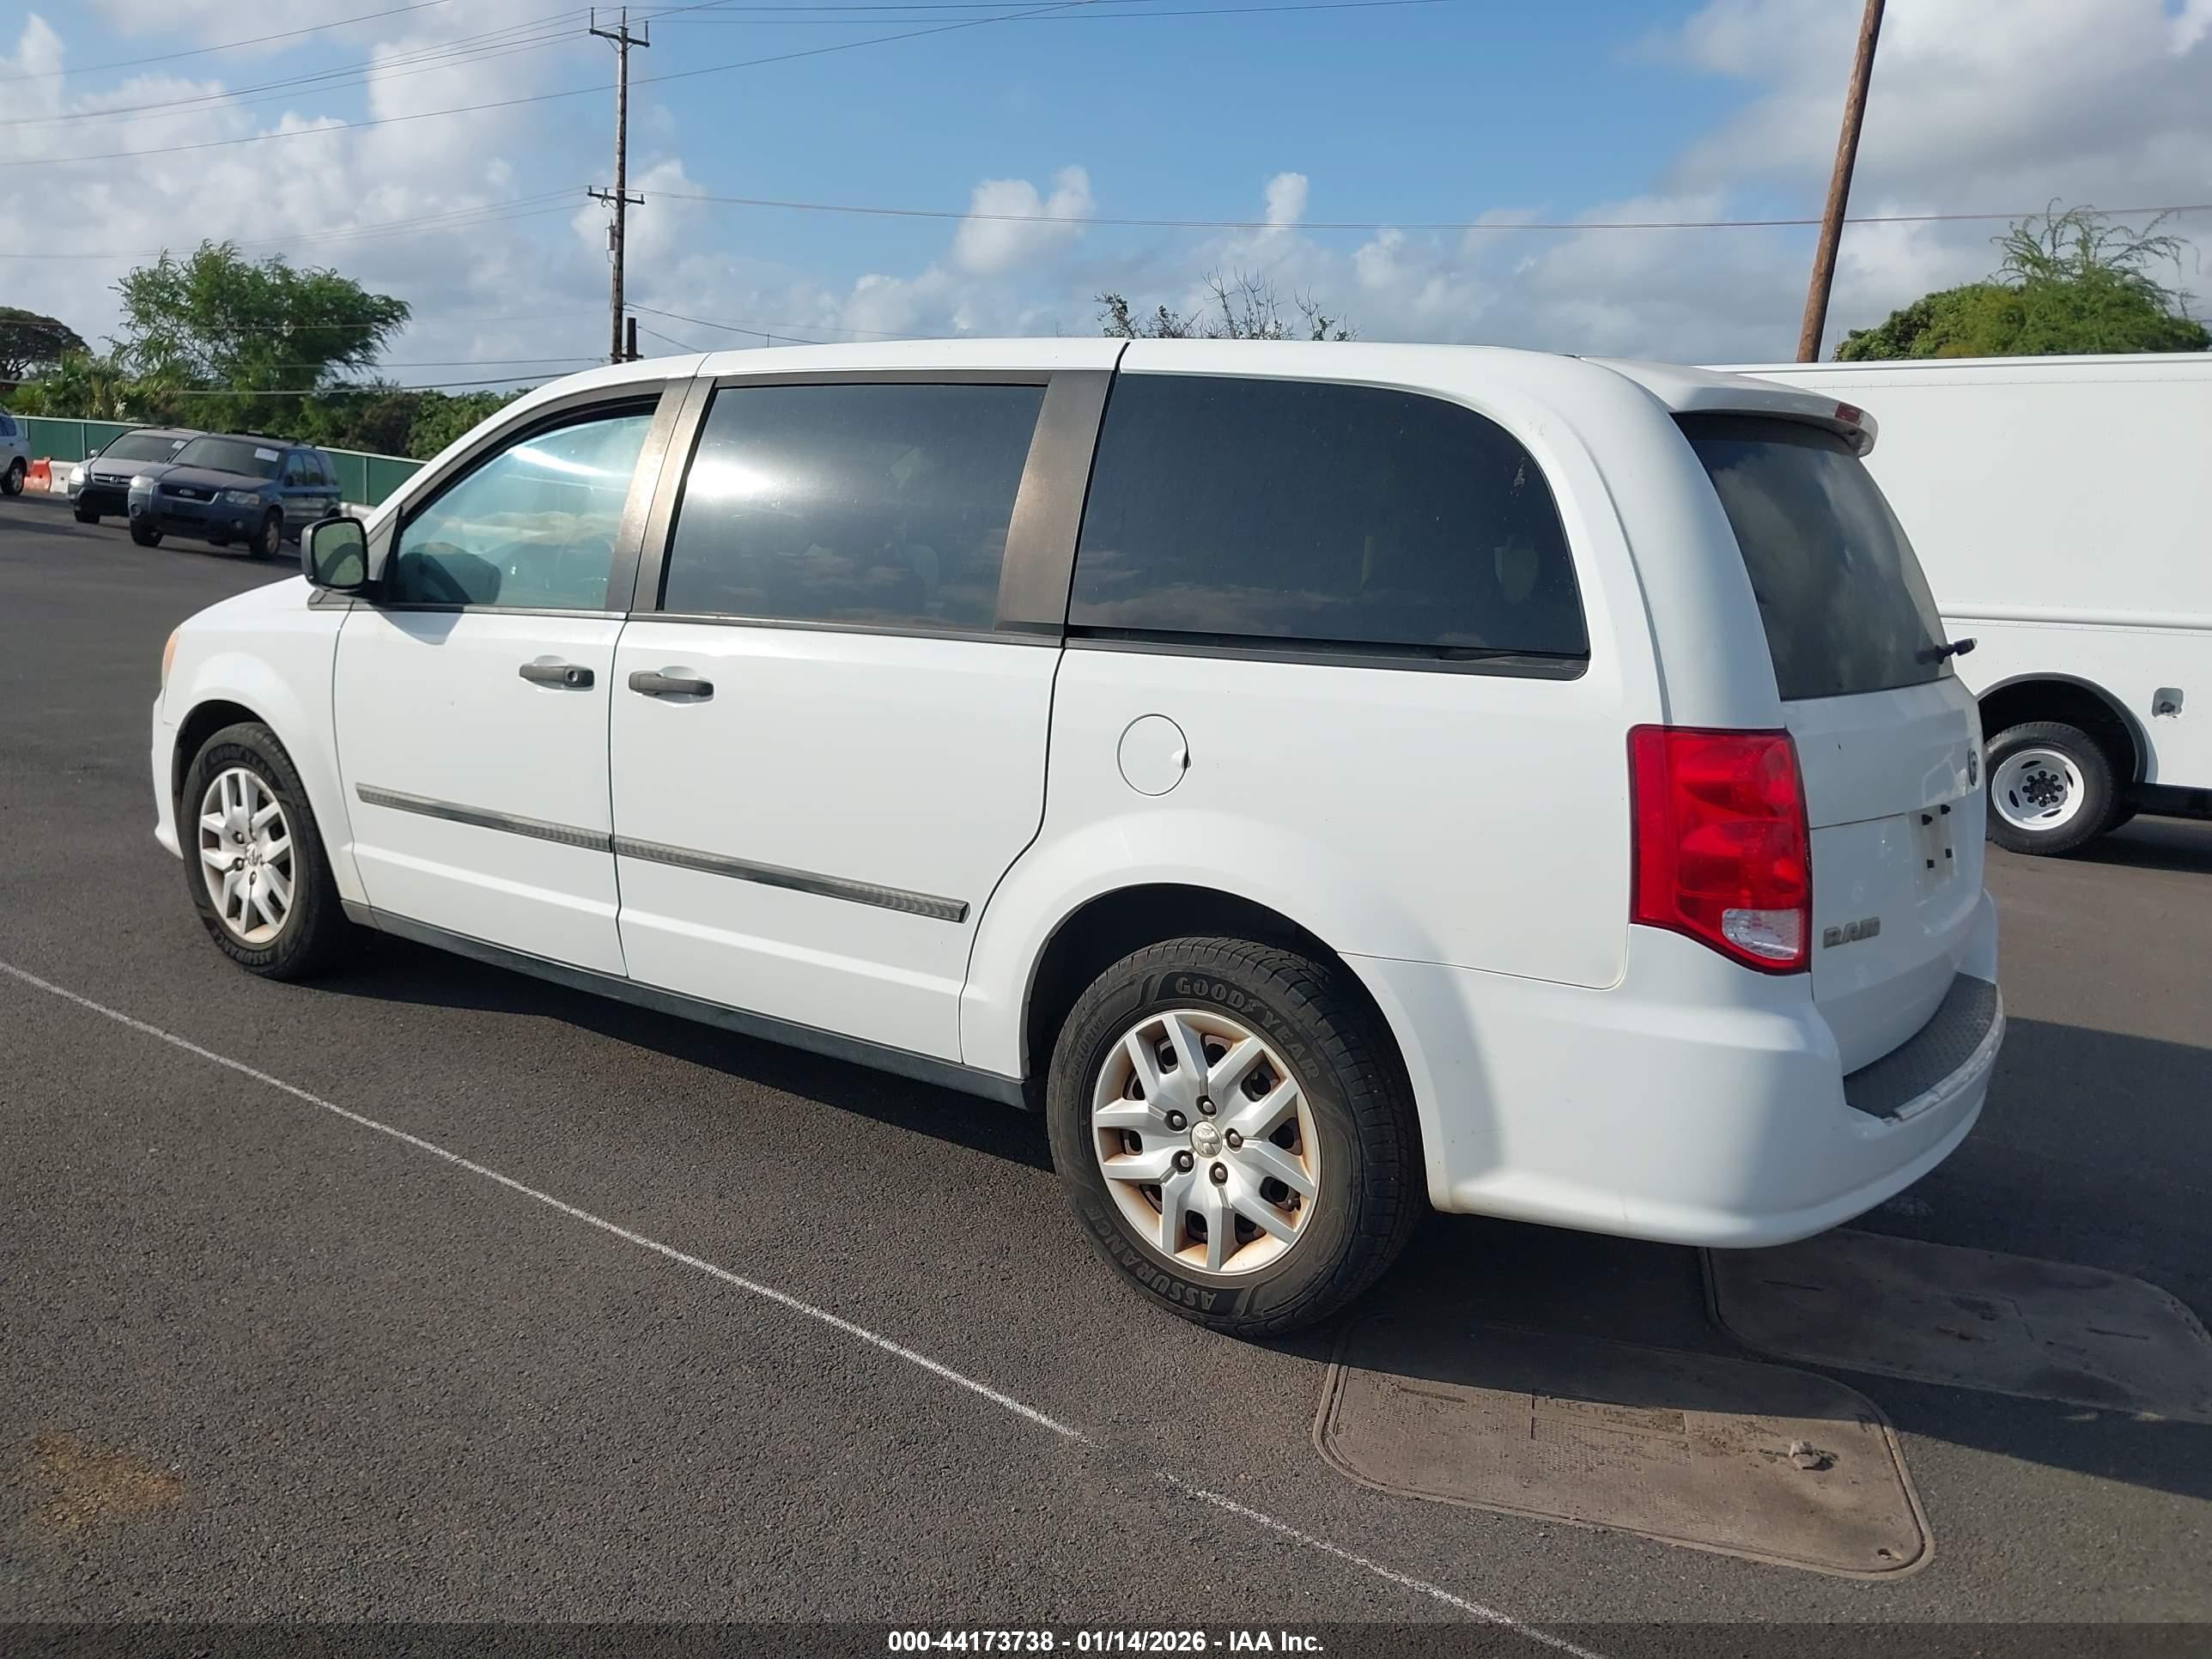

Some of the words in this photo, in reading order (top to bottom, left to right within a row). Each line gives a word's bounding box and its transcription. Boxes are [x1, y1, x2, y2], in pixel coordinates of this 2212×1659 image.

[1822, 916, 1881, 949] RAM
[1175, 976, 1321, 1080] GOODYEAR
[1085, 1205, 1218, 1311] ASSURANCE
